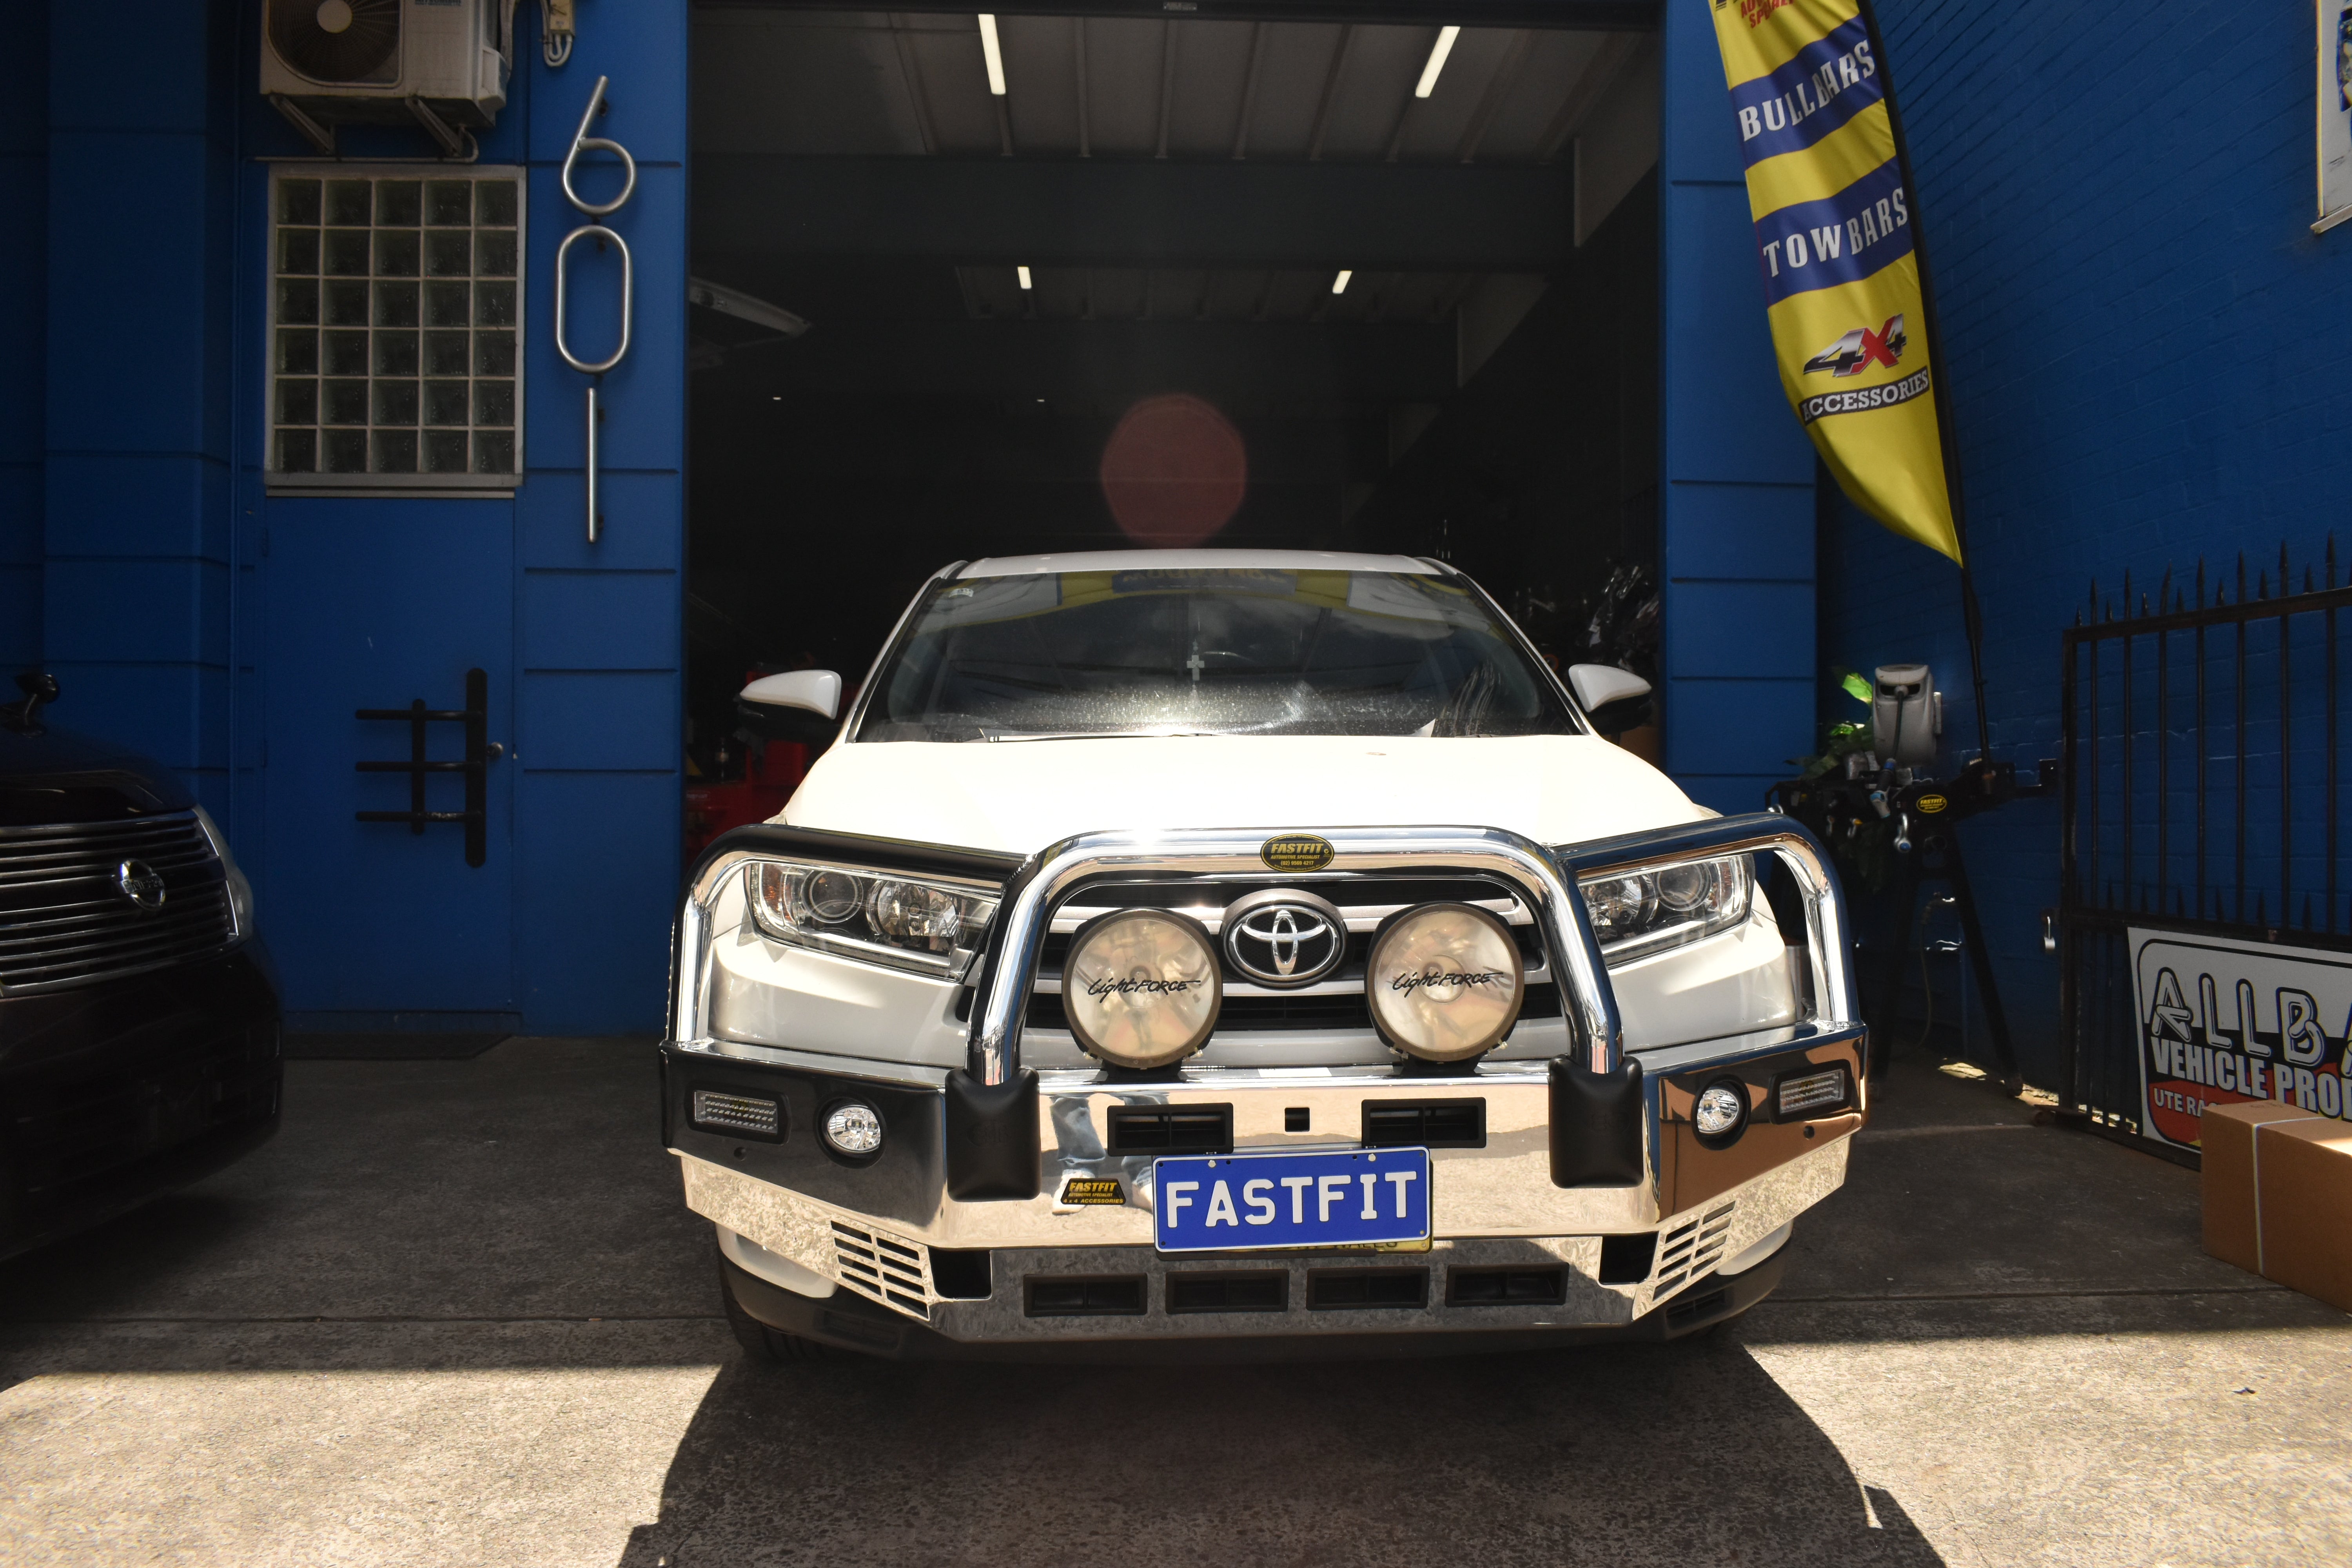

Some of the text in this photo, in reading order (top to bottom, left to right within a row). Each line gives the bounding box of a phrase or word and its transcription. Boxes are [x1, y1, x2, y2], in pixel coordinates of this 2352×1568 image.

[1739, 40, 1876, 142] BULLBARS
[1802, 369, 1928, 422] ACCESSORIES
[1270, 843, 1324, 853] FASTFIT
[2151, 1036, 2269, 1099] VEHICLE
[2154, 1087, 2220, 1117] UTE RA
[1069, 1182, 1117, 1192] FASTFIT
[1166, 1171, 1417, 1228] FASTFIT
